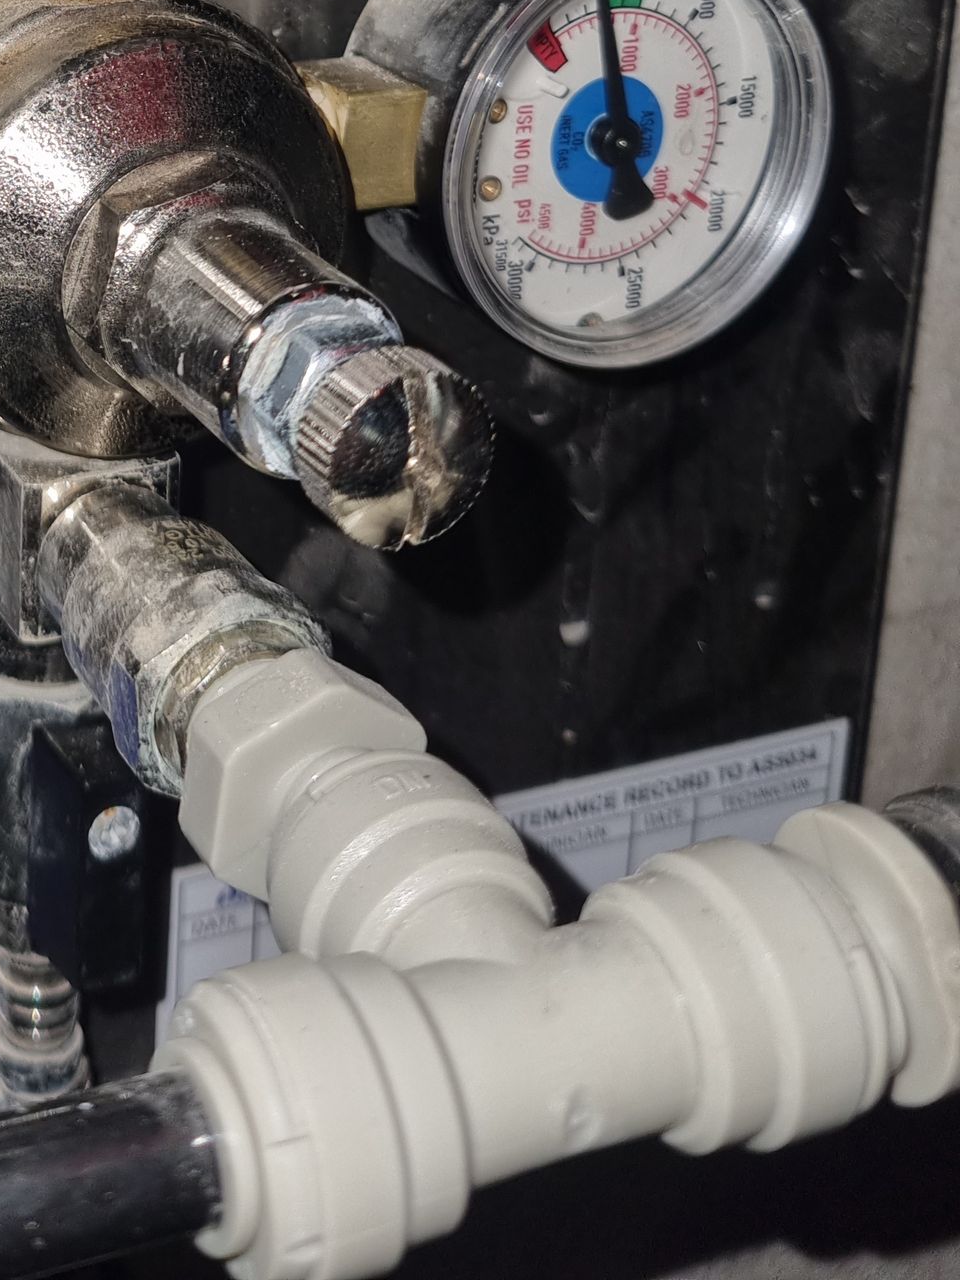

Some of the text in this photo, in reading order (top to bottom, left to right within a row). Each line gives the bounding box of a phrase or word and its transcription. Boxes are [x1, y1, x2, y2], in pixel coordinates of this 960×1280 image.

[620, 38, 639, 72] 1000
[674, 83, 692, 119] 2000
[737, 75, 758, 119] 15000
[511, 105, 535, 224] USE NO OIL psi
[652, 166, 668, 199] 3000
[538, 203, 551, 230] 4500
[580, 202, 597, 235] 4000
[707, 190, 725, 232] 20000
[482, 215, 500, 246] kPa
[495, 239, 508, 272] 31500
[626, 266, 643, 309] 25000
